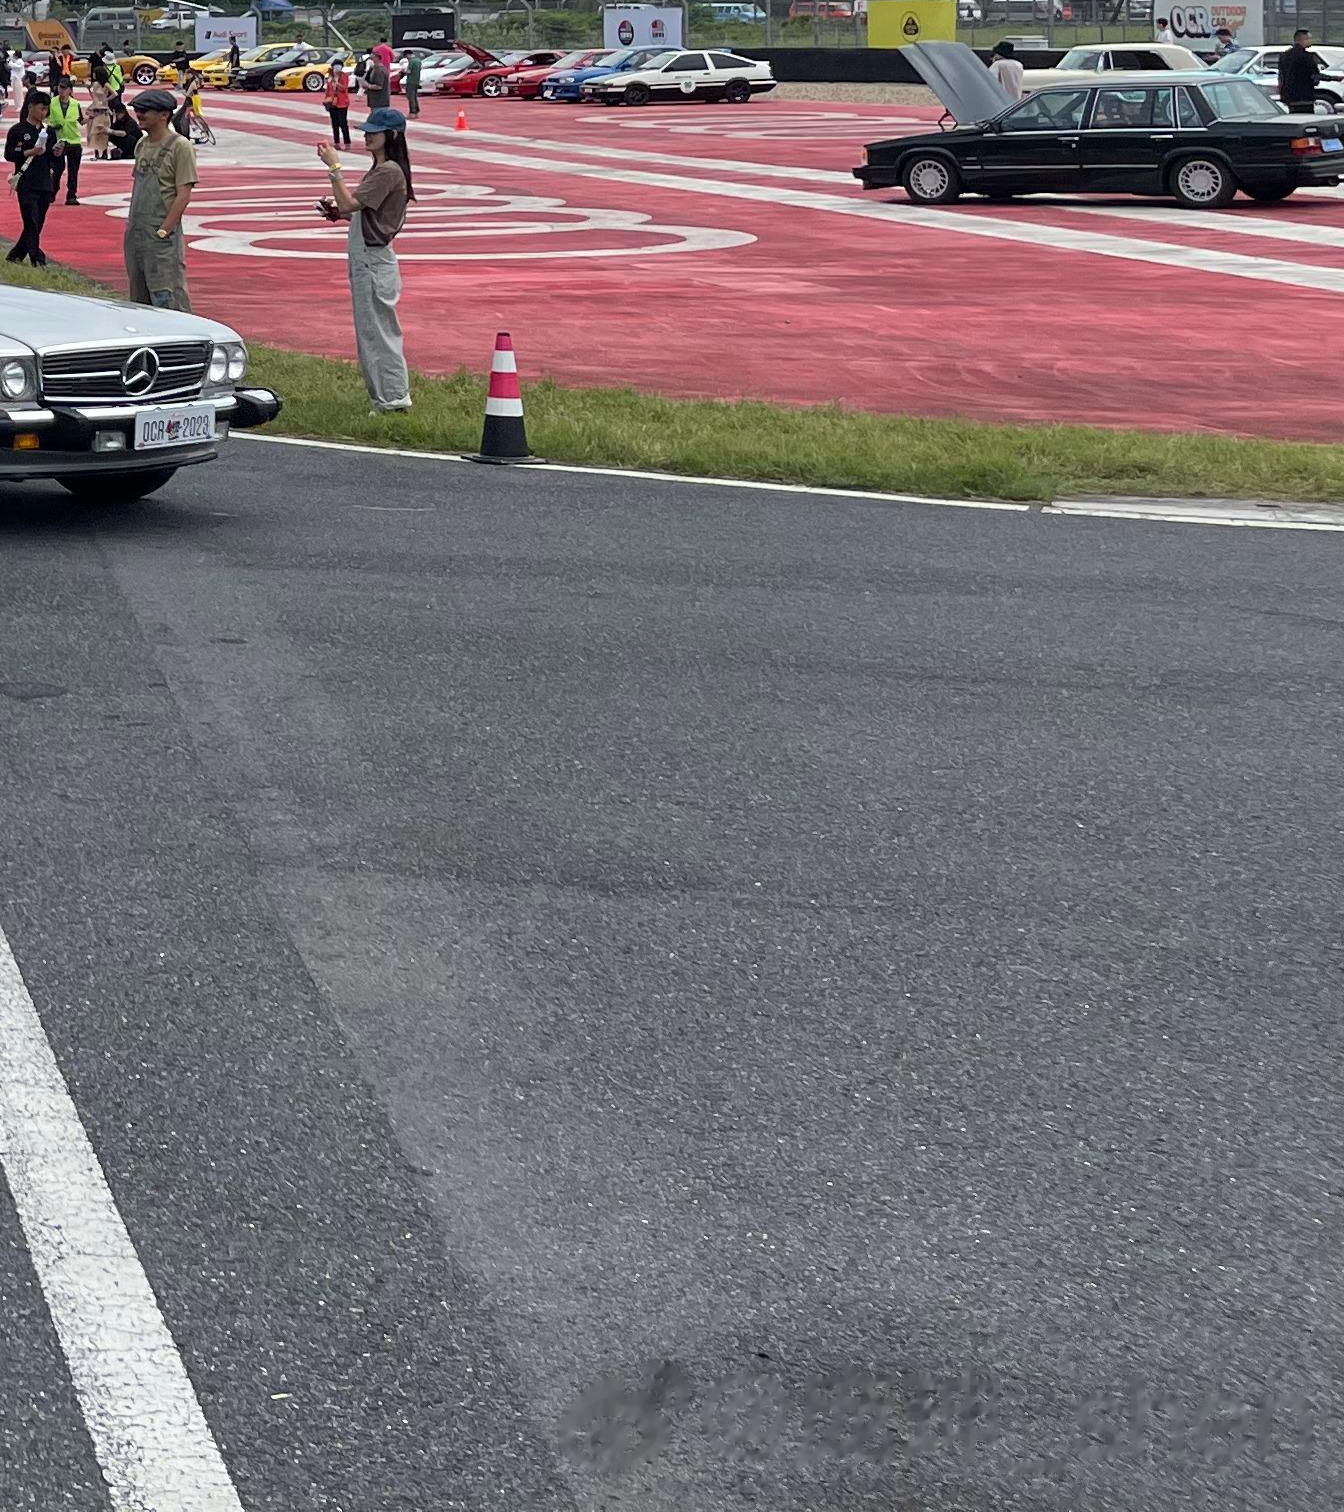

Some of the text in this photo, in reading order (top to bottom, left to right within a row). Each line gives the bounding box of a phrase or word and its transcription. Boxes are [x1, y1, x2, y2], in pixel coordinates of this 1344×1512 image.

[1211, 6, 1247, 16] OUTDOOR
[1170, 6, 1210, 38] OCR
[416, 30, 445, 40] AMG
[143, 415, 210, 442] OCR 2023
